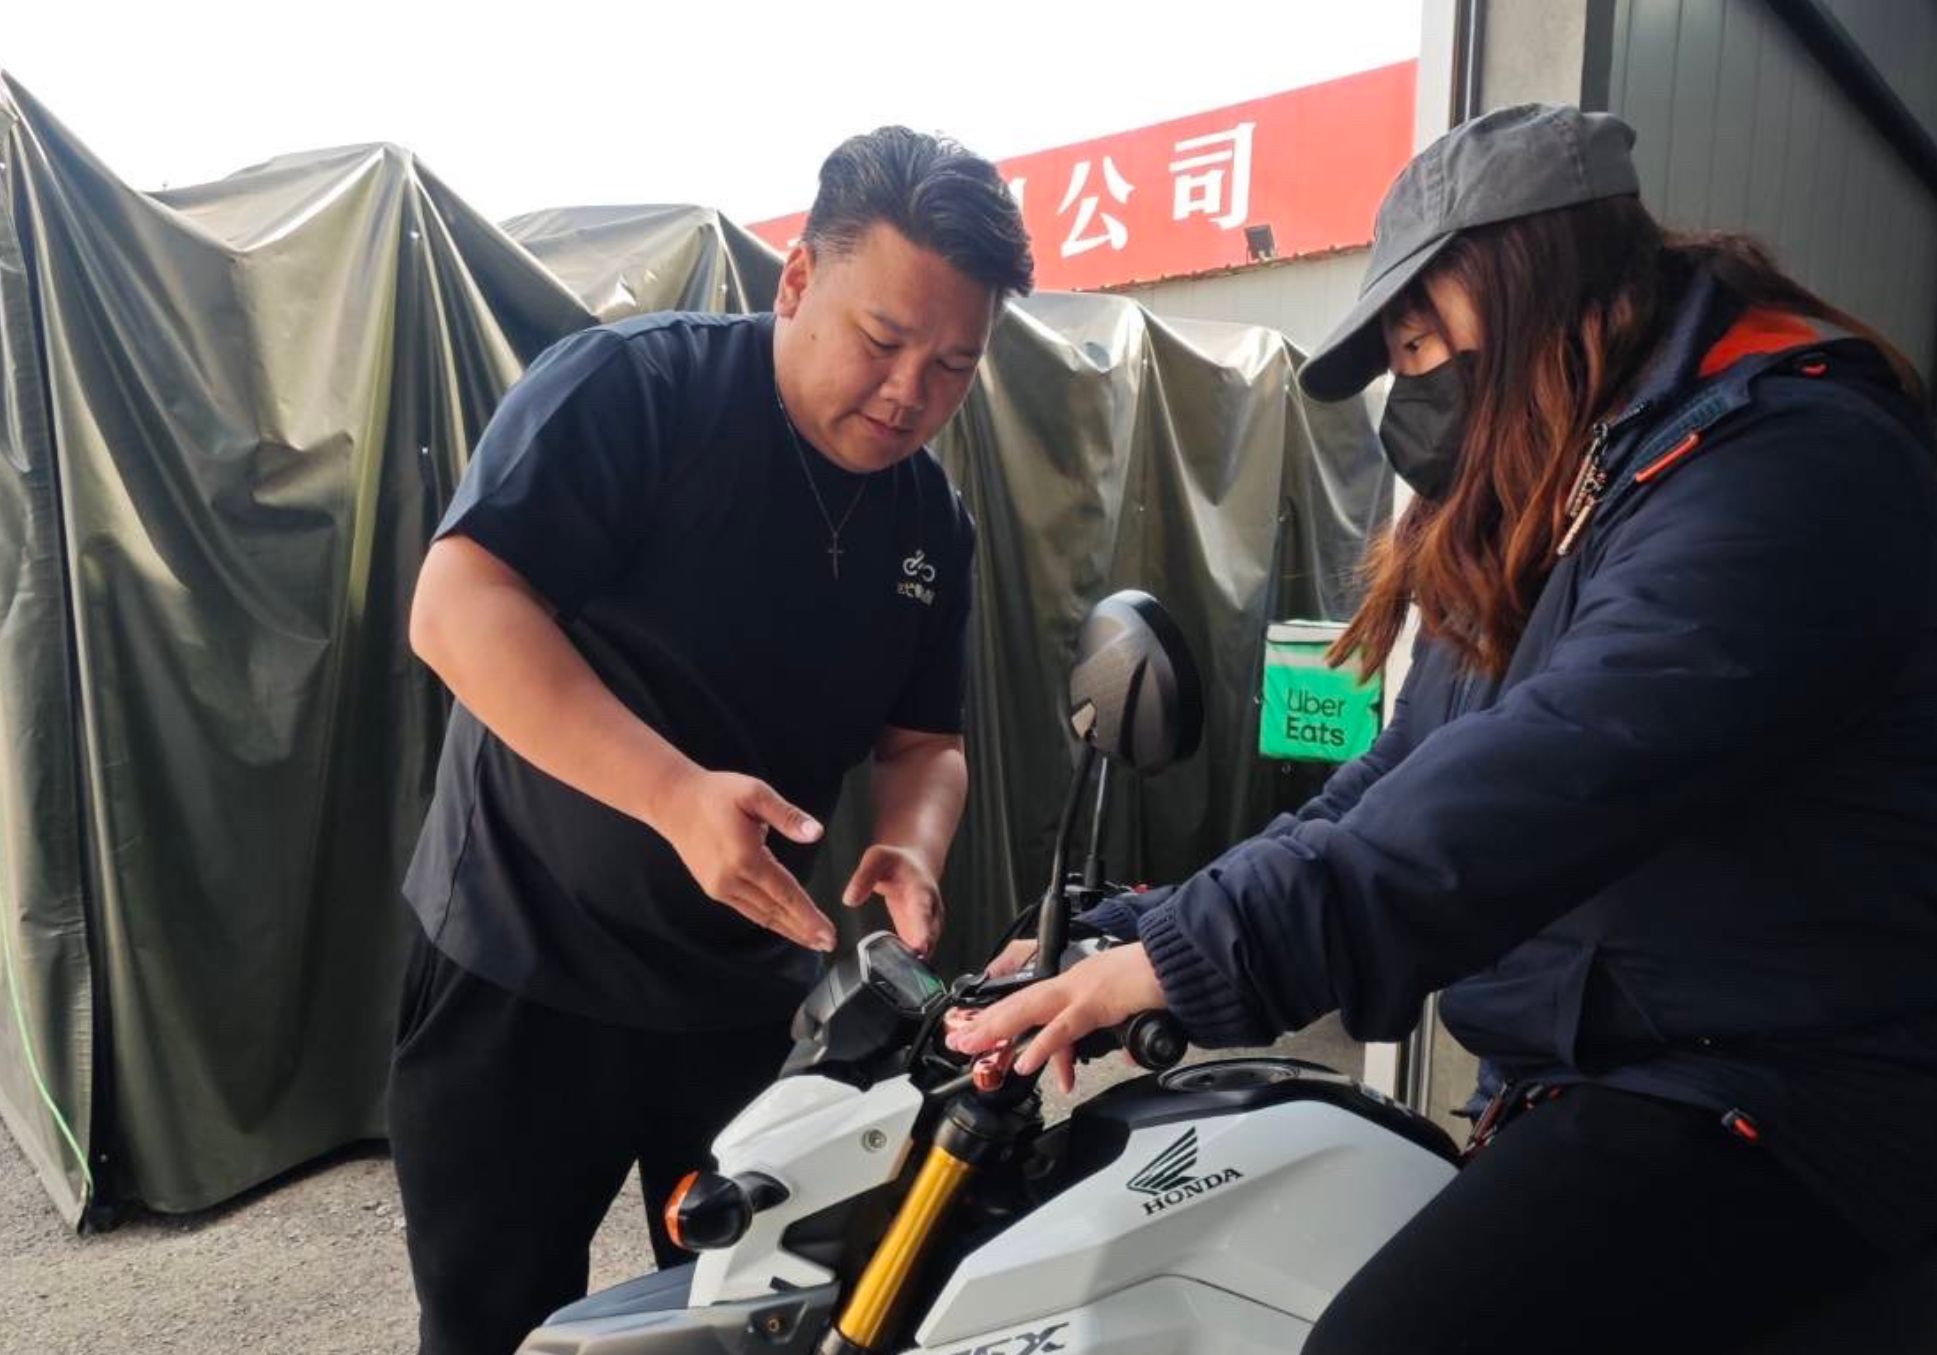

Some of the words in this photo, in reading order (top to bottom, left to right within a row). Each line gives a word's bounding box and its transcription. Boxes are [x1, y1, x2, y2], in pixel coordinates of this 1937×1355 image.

[1008, 121, 1256, 258] 公司
[1288, 688, 1345, 717] Uber
[1286, 716, 1345, 746] Eats
[1142, 1168, 1244, 1215] HONDA
